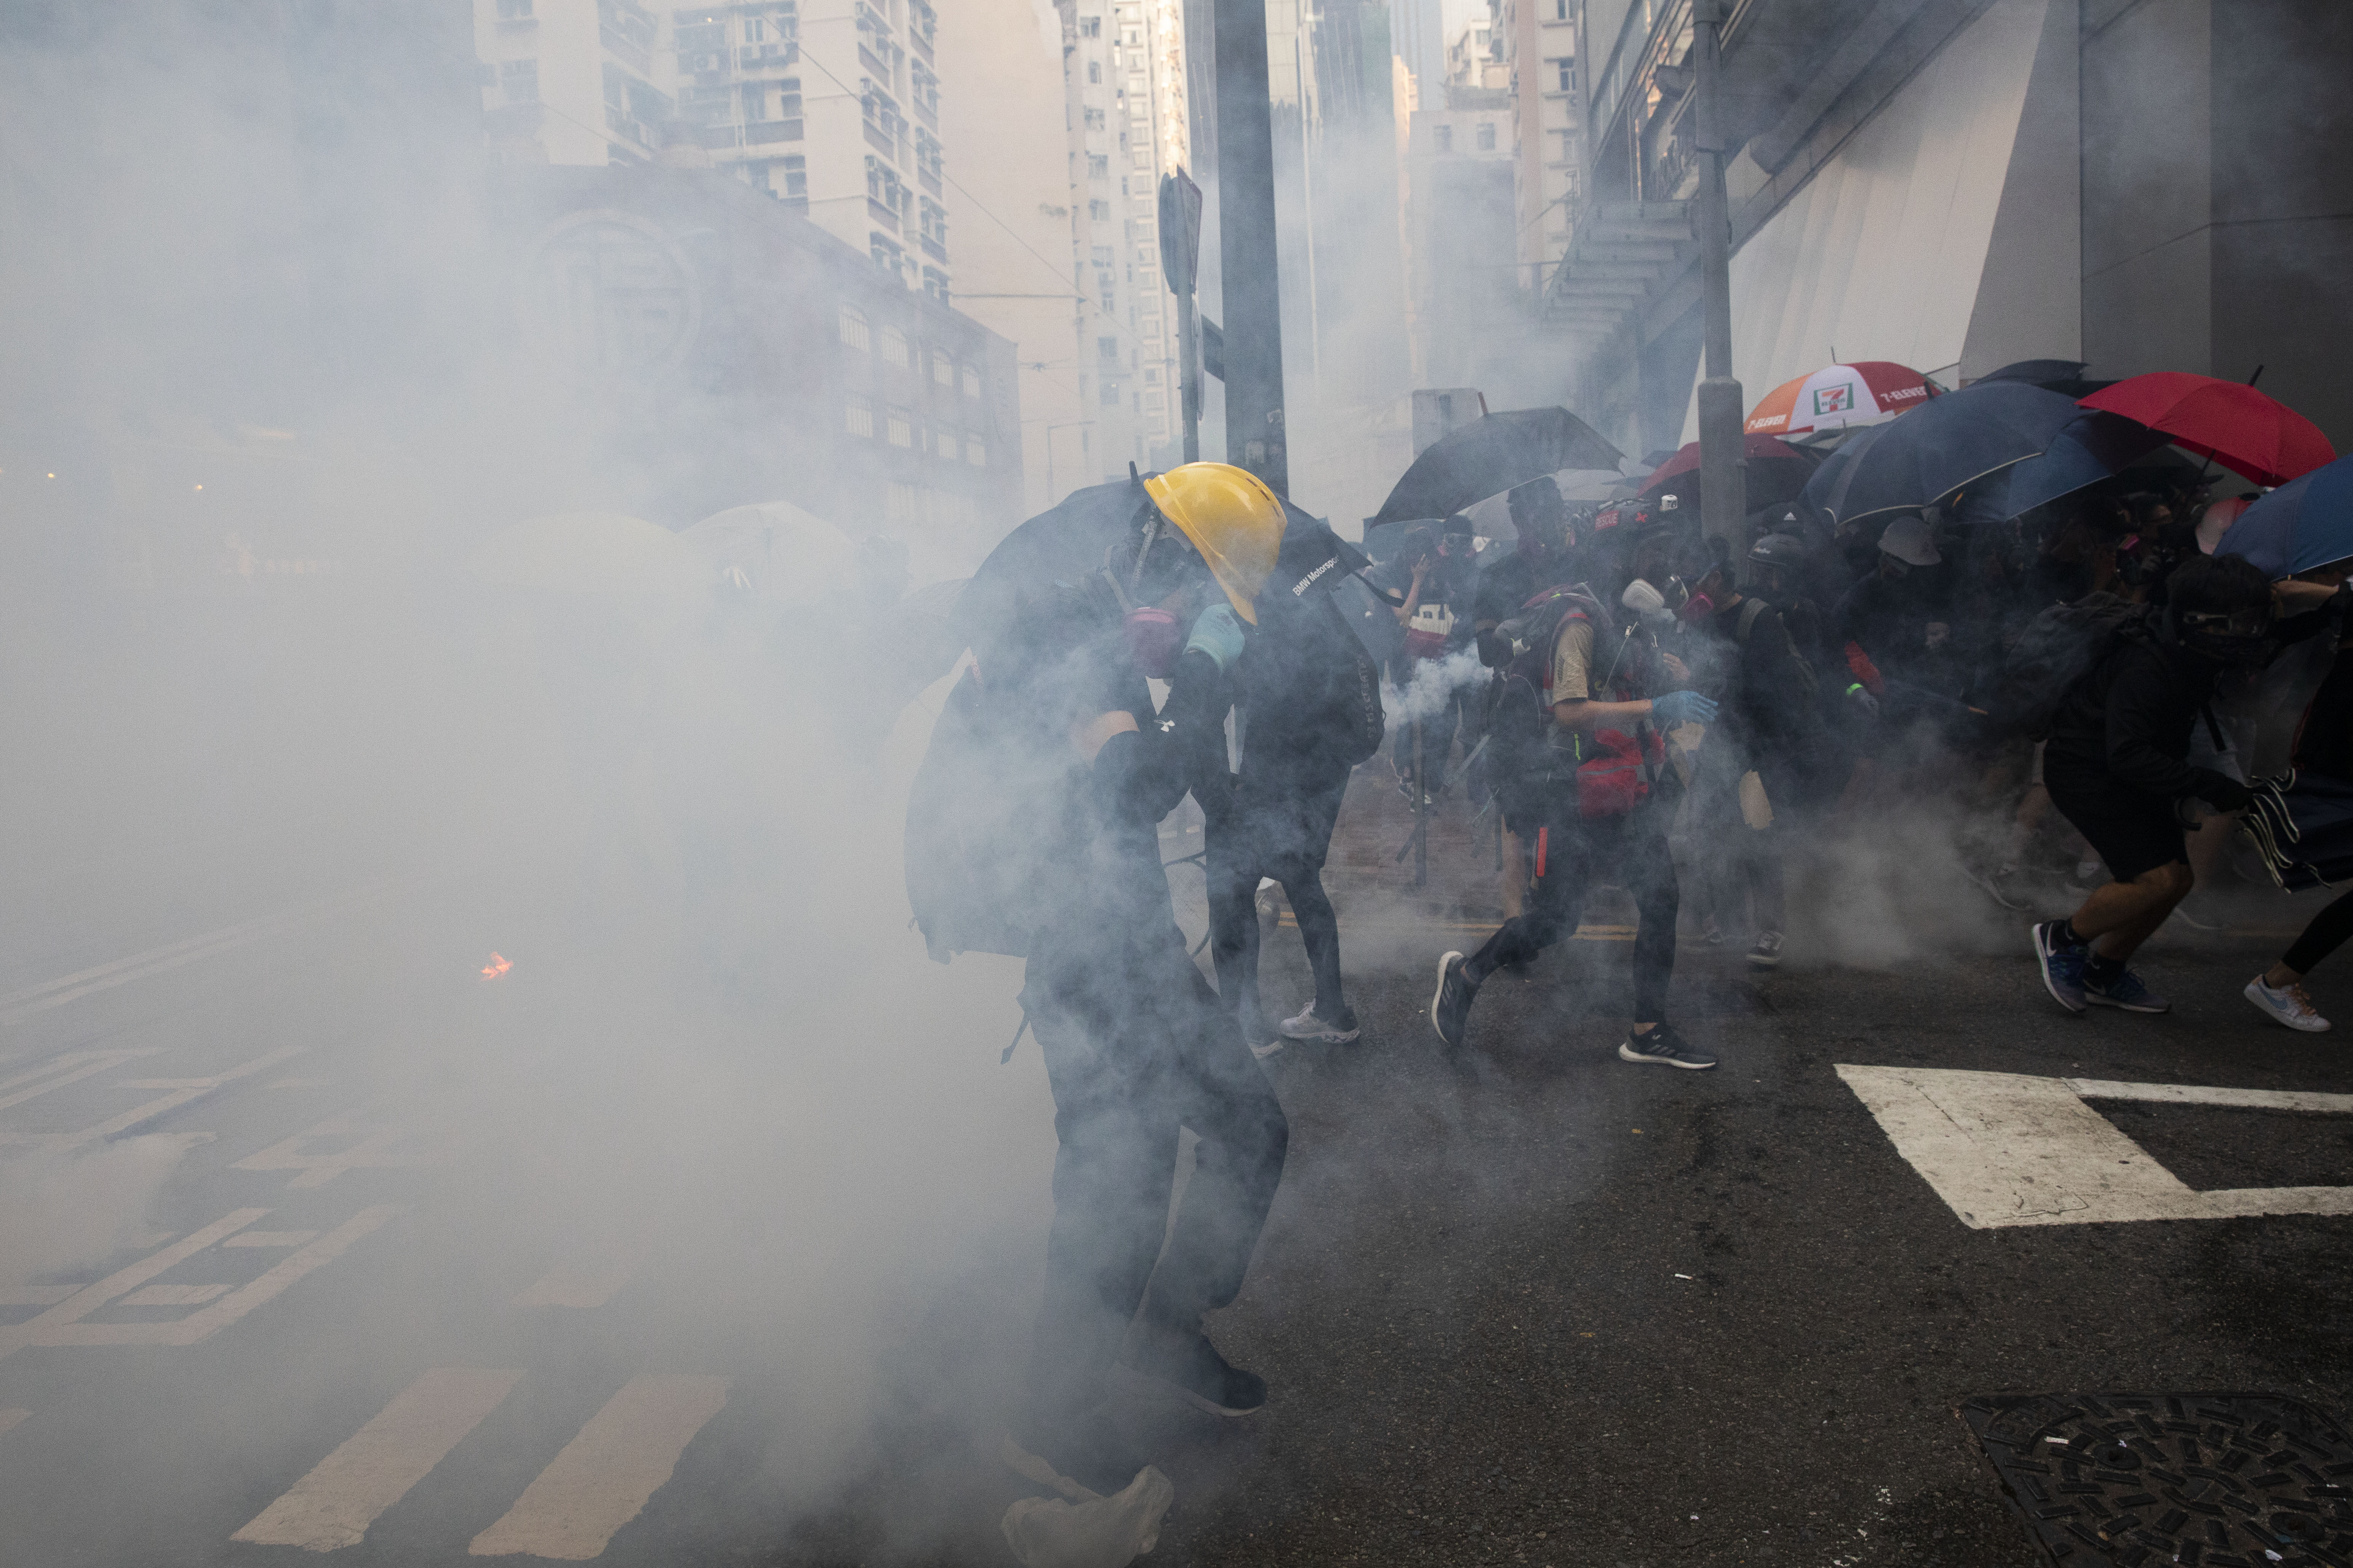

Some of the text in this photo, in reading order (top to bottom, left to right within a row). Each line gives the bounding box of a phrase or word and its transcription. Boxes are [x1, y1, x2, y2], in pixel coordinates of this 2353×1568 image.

[1880, 386, 1927, 402] 7-ELEVE
[1595, 513, 1618, 528] RESCUE
[1292, 554, 1340, 596] BMW Motorspor
